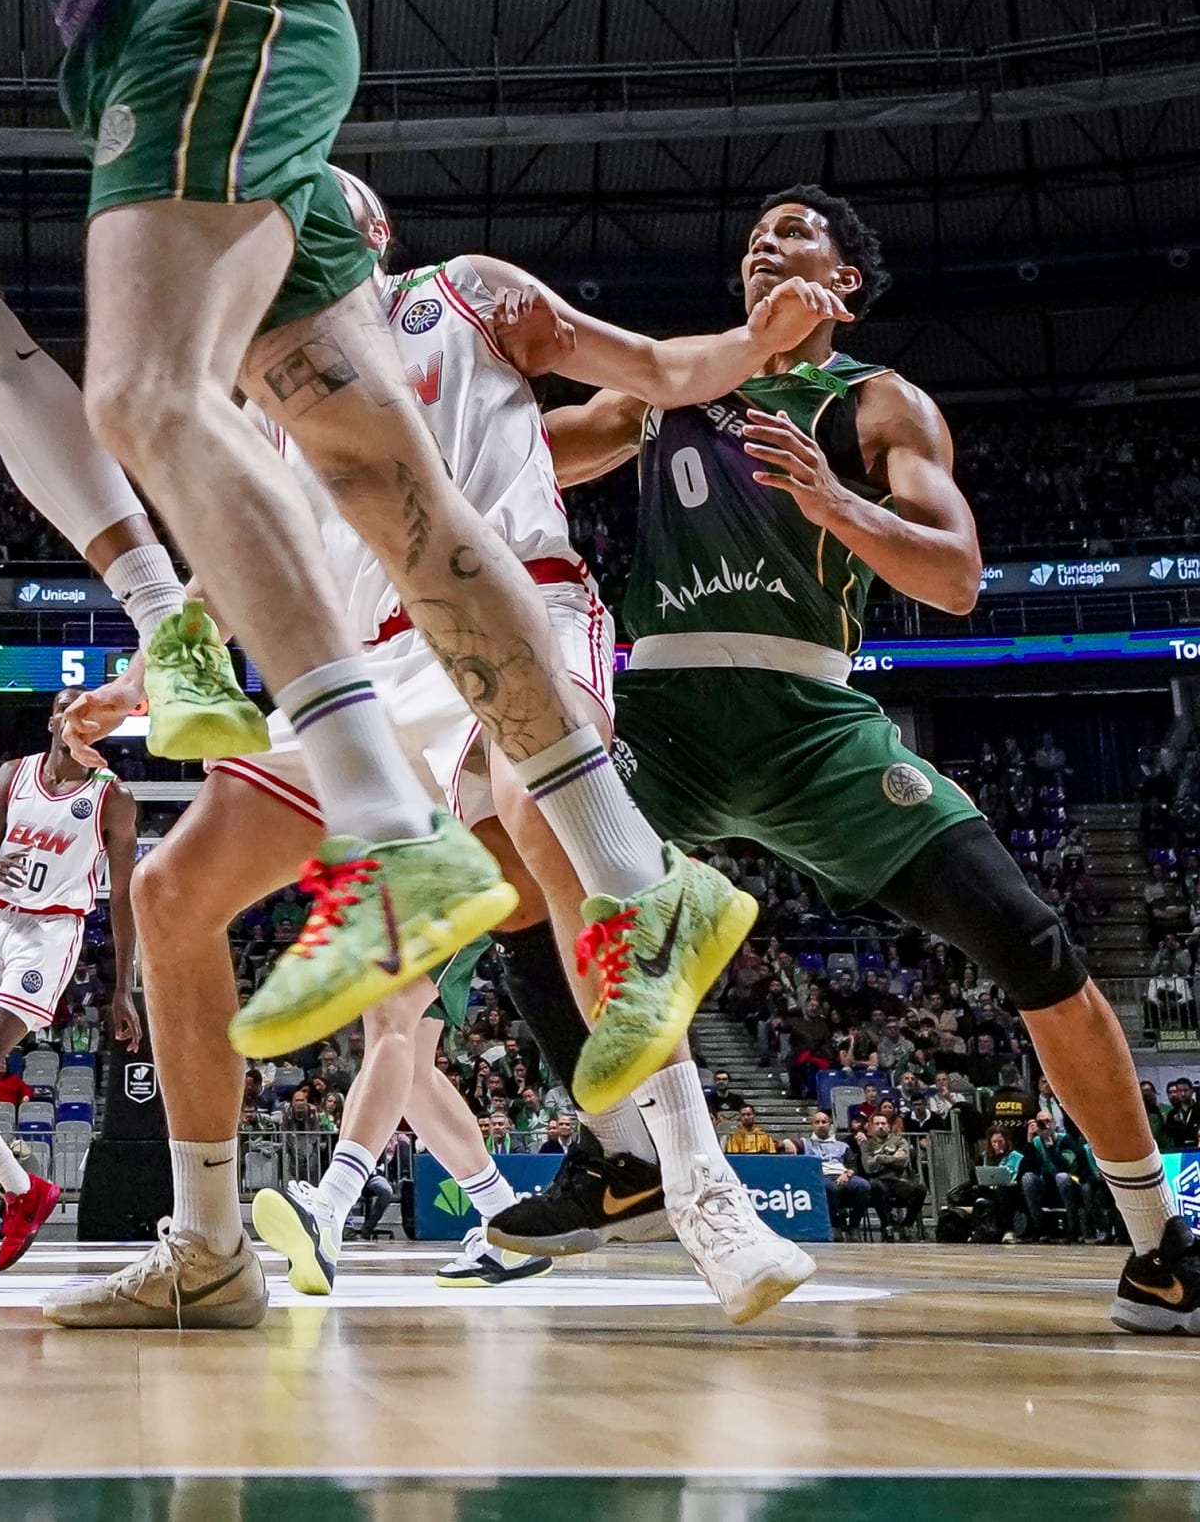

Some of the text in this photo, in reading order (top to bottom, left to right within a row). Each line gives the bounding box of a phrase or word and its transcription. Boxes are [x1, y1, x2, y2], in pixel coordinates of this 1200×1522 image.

[670, 446, 709, 508] 0
[1057, 561, 1120, 575] Fundación
[1058, 572, 1104, 587] Unicaja
[42, 589, 86, 603] Unicaja
[655, 554, 797, 620] Andalucía
[61, 650, 85, 686] 5
[6, 819, 80, 856] ELAN
